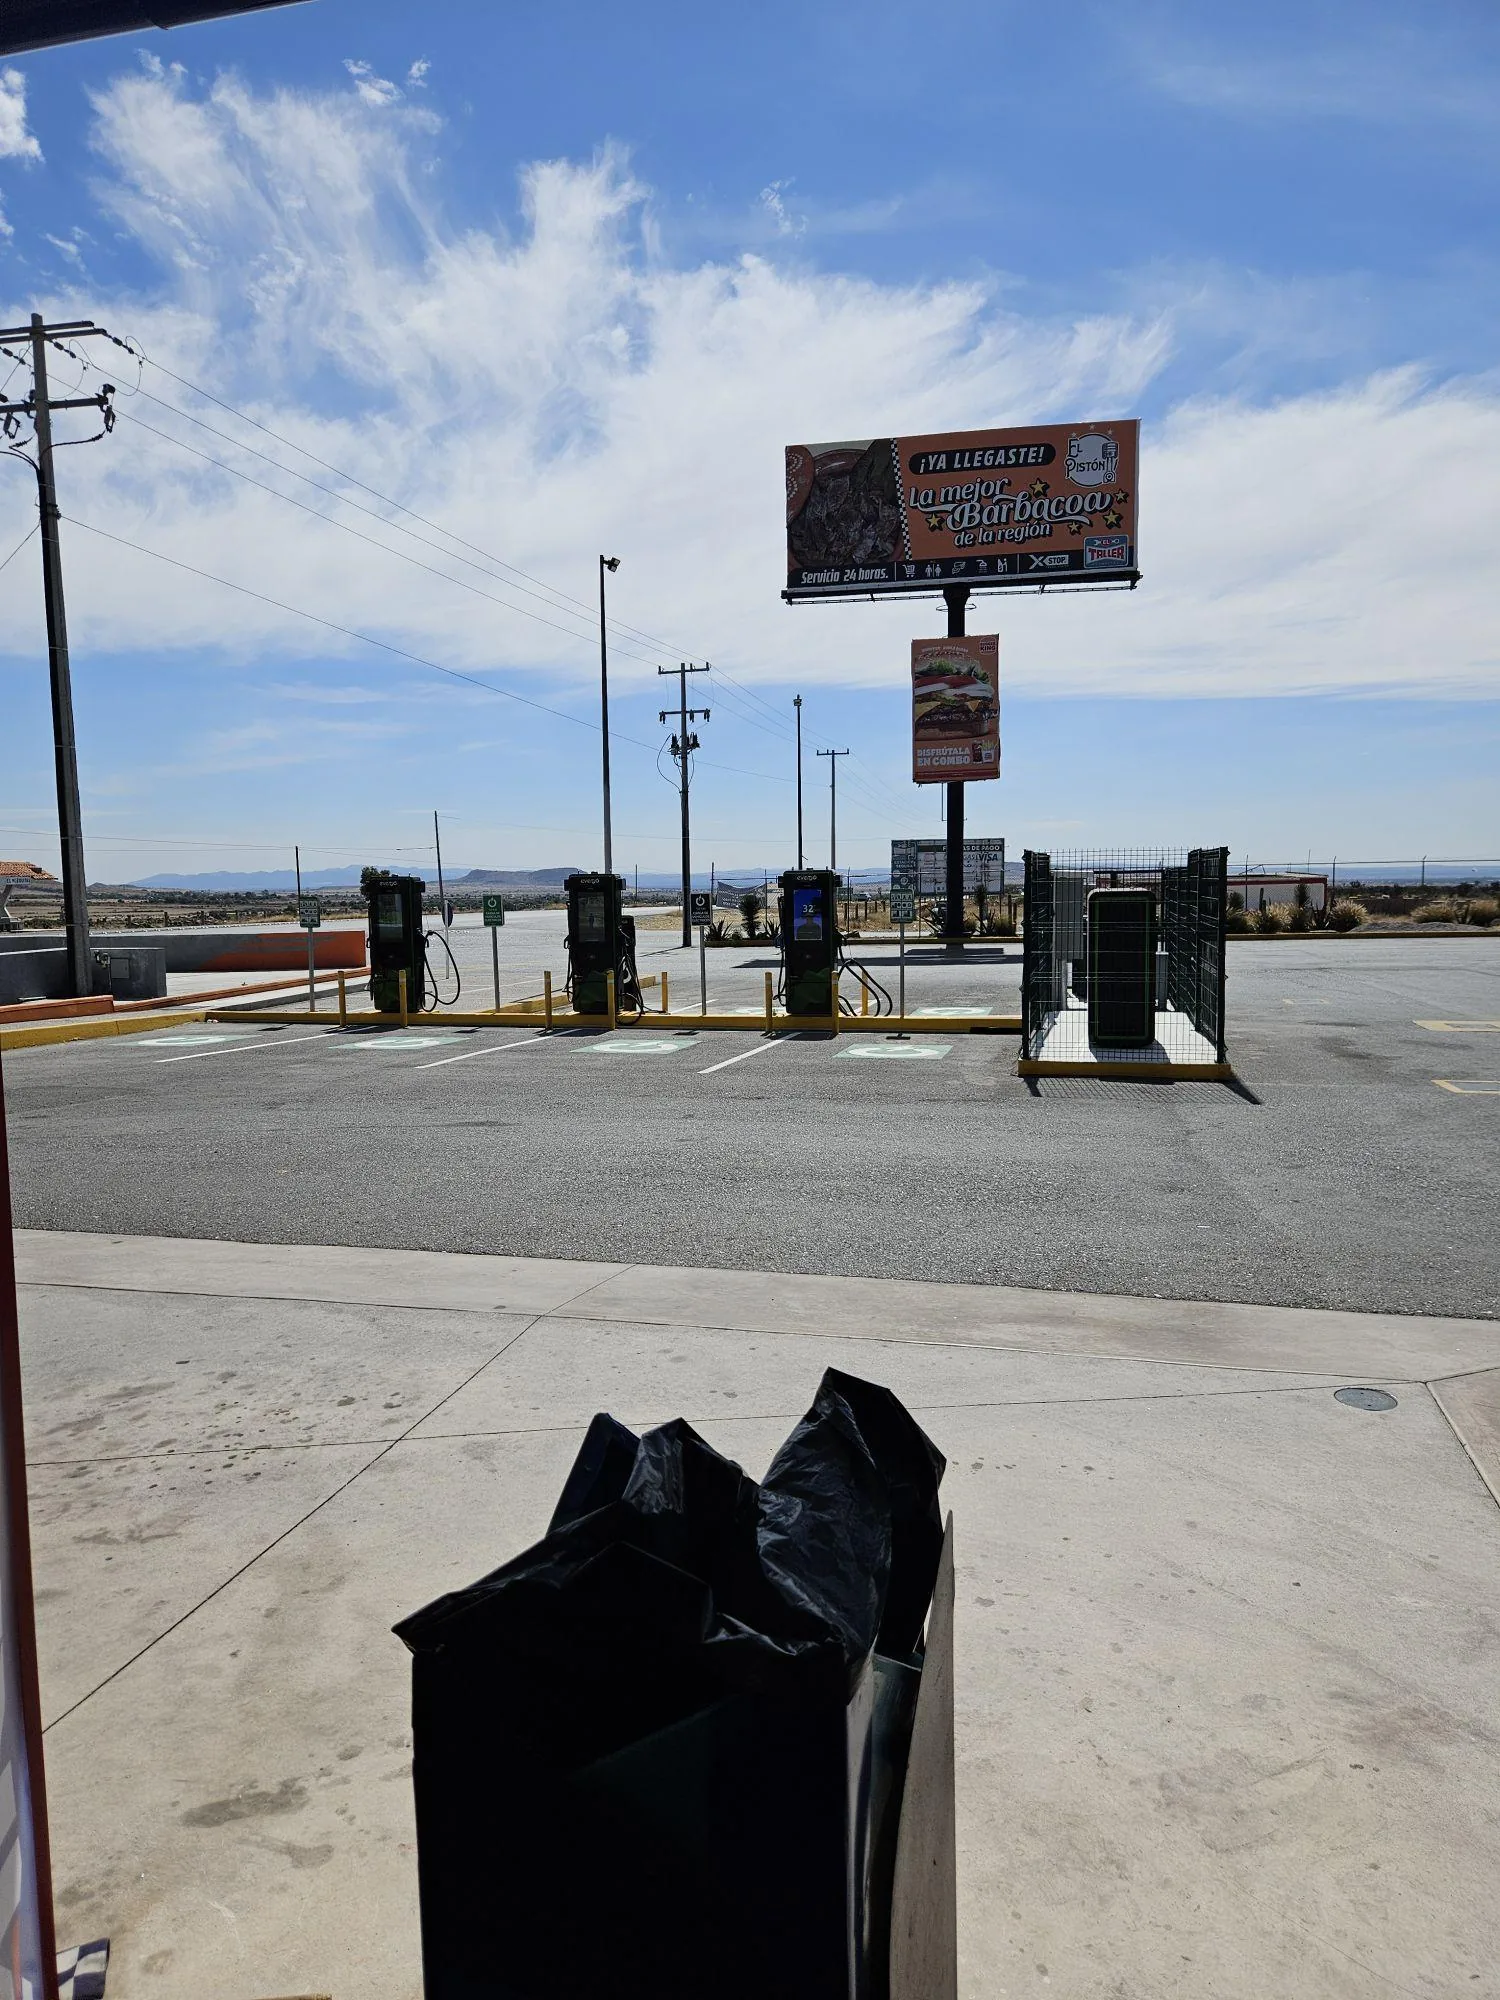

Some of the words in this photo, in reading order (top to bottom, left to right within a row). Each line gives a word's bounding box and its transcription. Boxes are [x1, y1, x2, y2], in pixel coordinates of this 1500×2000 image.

[1068, 438, 1084, 457] EL
[918, 451, 948, 472] ¡YA
[953, 446, 1045, 469] LLEGASTE!
[1065, 458, 1106, 478] PISTÓN
[909, 485, 934, 508] La
[939, 476, 1010, 505] mejor
[947, 490, 1111, 531] Barbacoa
[954, 530, 974, 547] de
[977, 528, 995, 543] la
[997, 521, 1051, 544] región
[1088, 545, 1124, 561] TALLER
[801, 571, 840, 584] Servicio
[843, 570, 858, 582] 24
[918, 757, 931, 767] EN
[932, 756, 971, 766] COMBO
[978, 853, 999, 862] VISA
